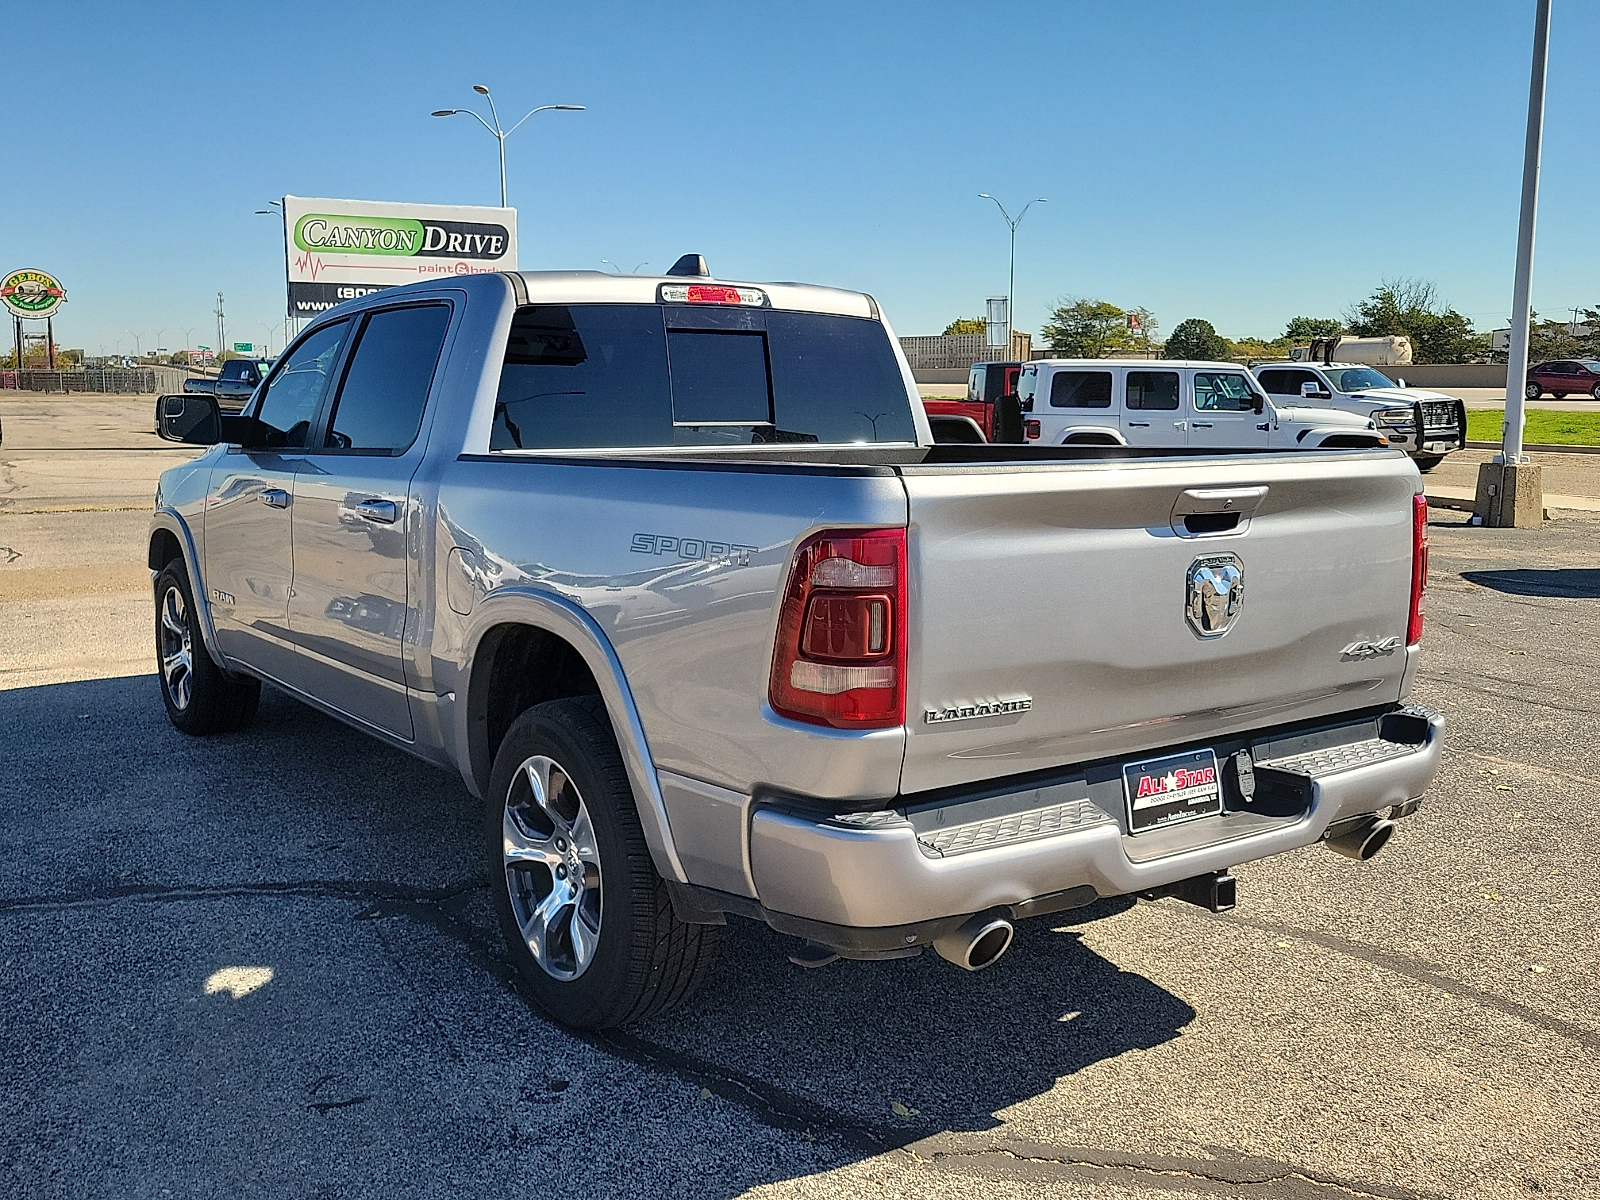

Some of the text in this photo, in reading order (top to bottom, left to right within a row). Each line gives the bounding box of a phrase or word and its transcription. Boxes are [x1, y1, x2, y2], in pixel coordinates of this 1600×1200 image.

[302, 219, 504, 254] CANYON DRIVE
[419, 264, 454, 274] paint
[630, 533, 759, 567] SPORT
[213, 589, 236, 606] RAM
[924, 697, 1033, 724] LARAMIE
[1174, 768, 1215, 790] STAR
